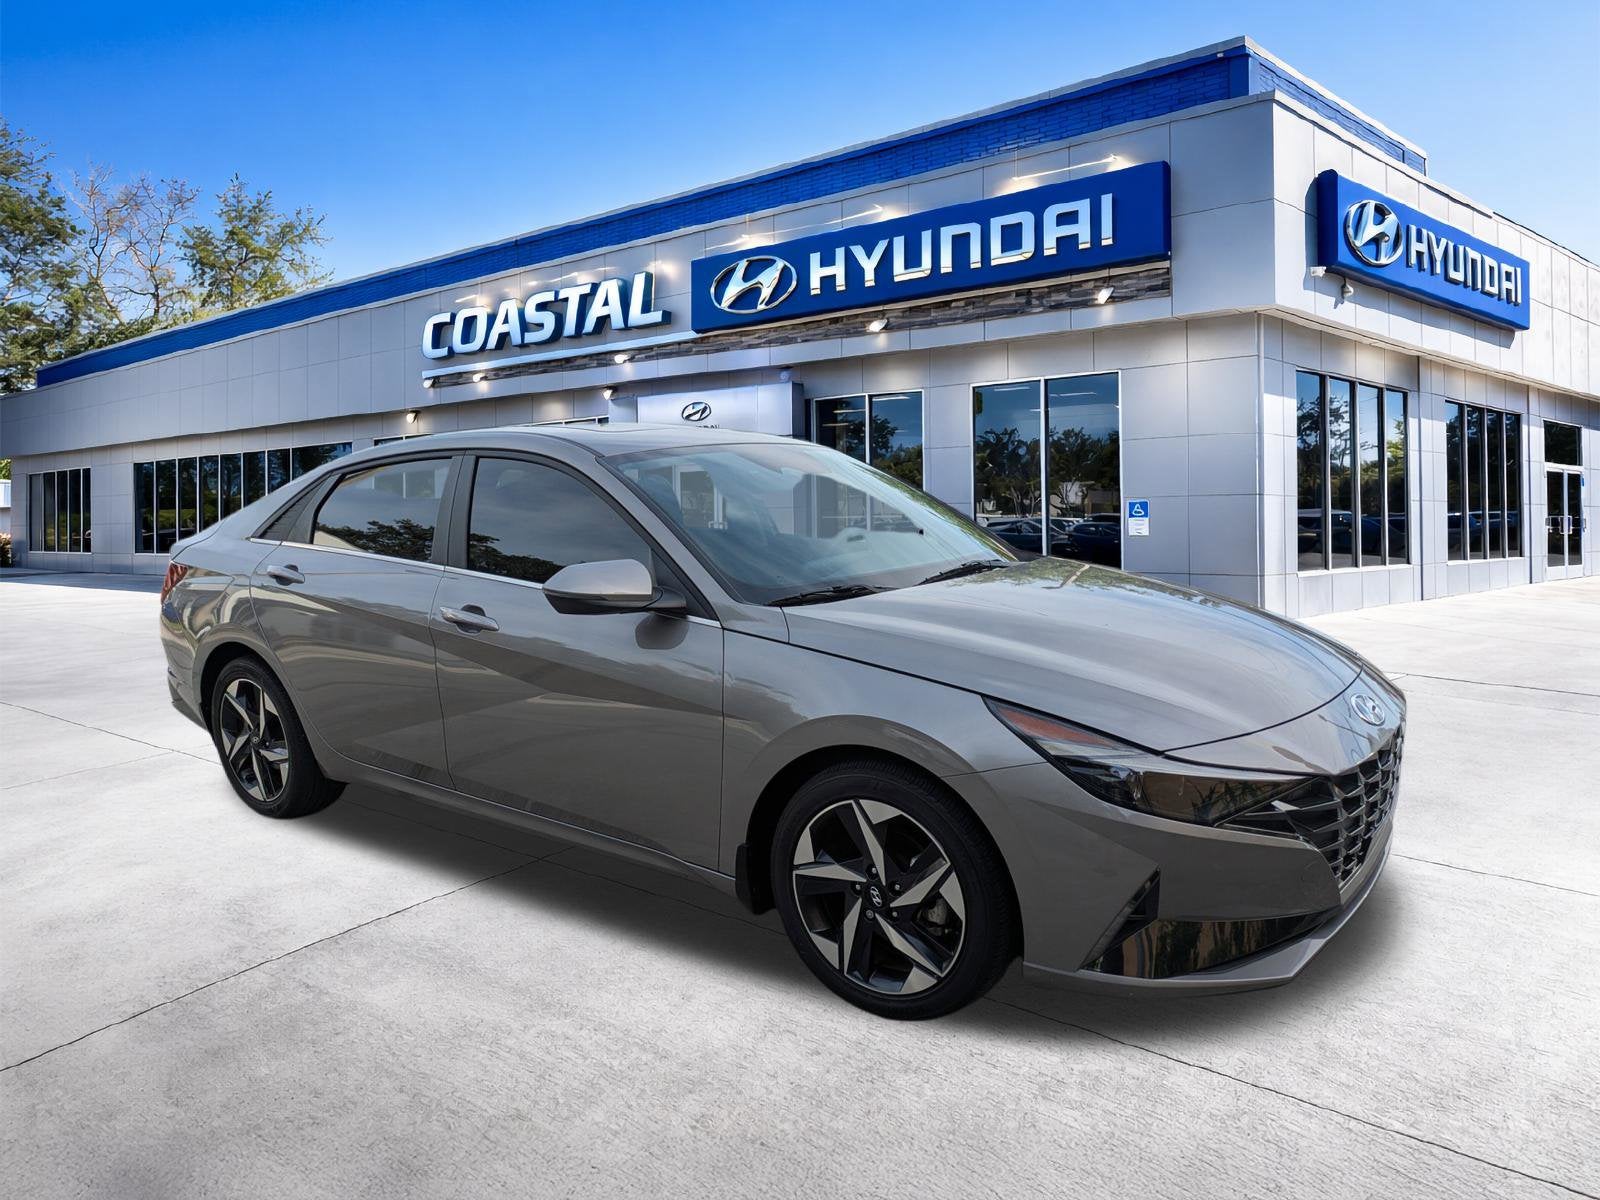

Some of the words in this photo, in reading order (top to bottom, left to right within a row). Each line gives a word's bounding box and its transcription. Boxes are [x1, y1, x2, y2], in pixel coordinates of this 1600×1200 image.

[809, 193, 1114, 296] HYUNDAI
[1407, 224, 1522, 305] HYUNDAI
[421, 271, 671, 360] COASTAL
